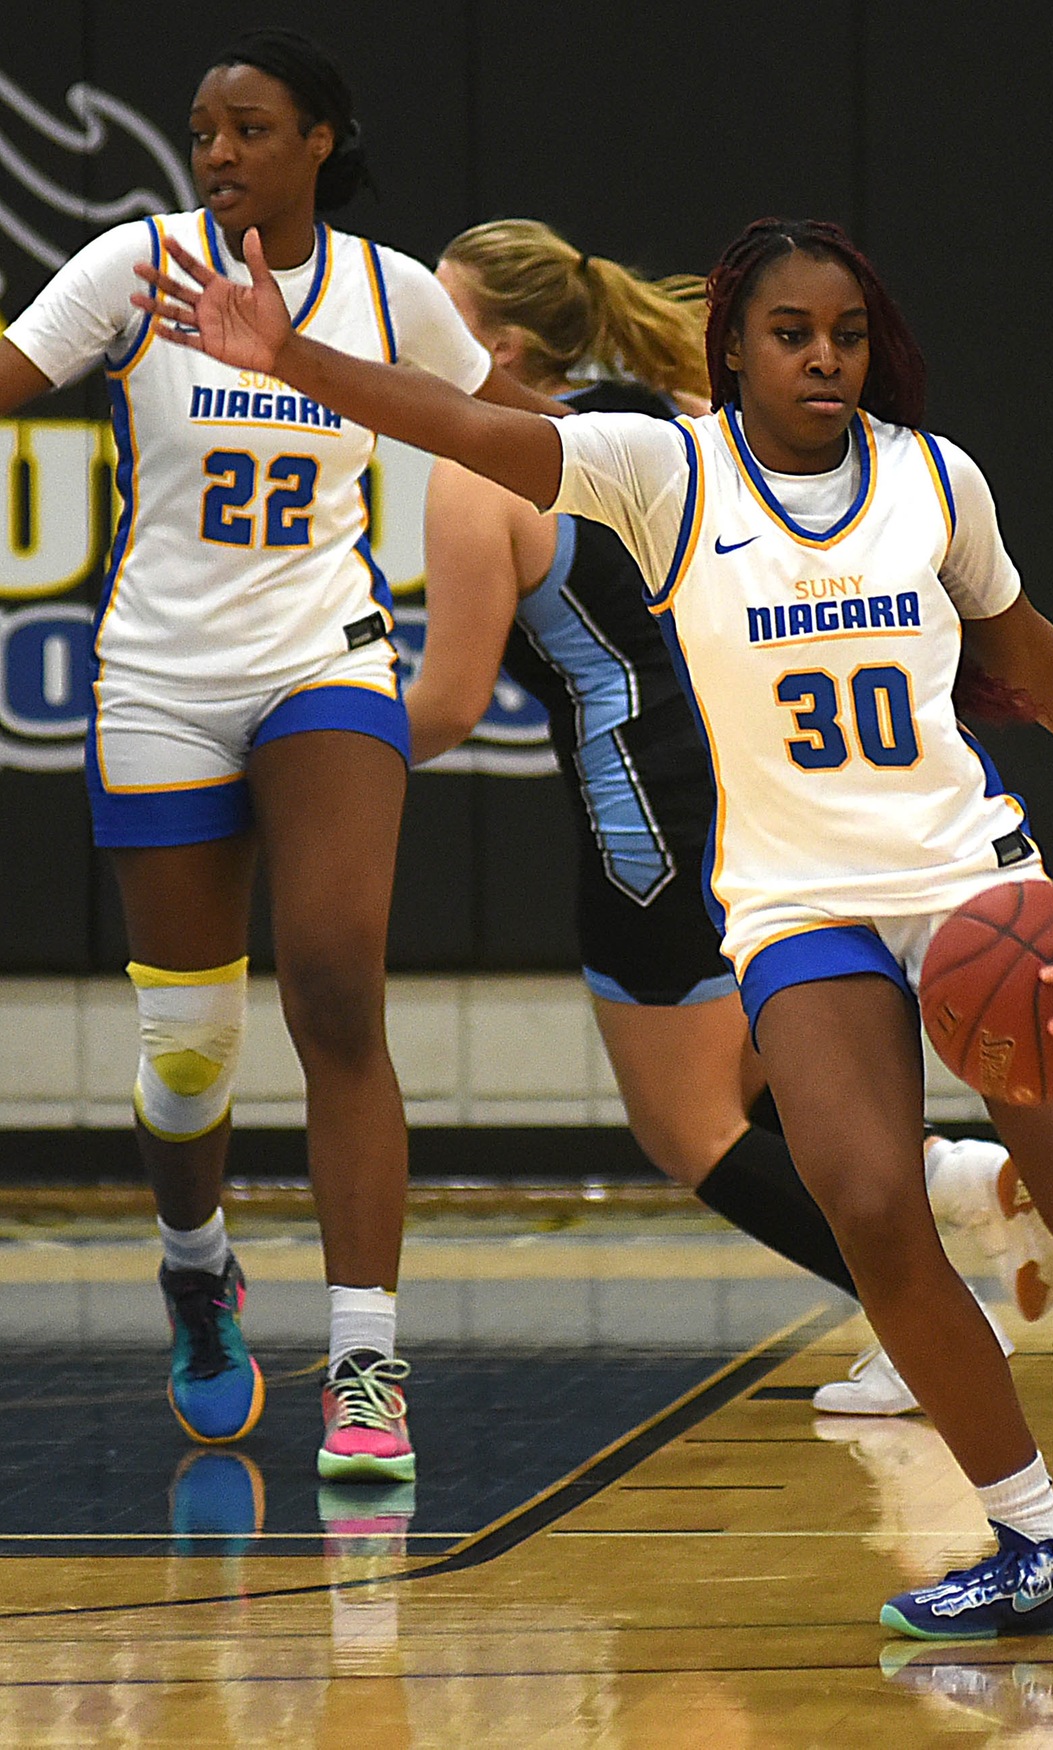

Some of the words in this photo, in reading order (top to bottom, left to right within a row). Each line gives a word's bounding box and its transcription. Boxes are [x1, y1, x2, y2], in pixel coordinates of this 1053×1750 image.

[238, 370, 298, 393] SUN
[200, 447, 320, 550] 22
[795, 575, 864, 600] SUNY
[747, 591, 922, 642] NIAGARA
[772, 661, 924, 774] 30
